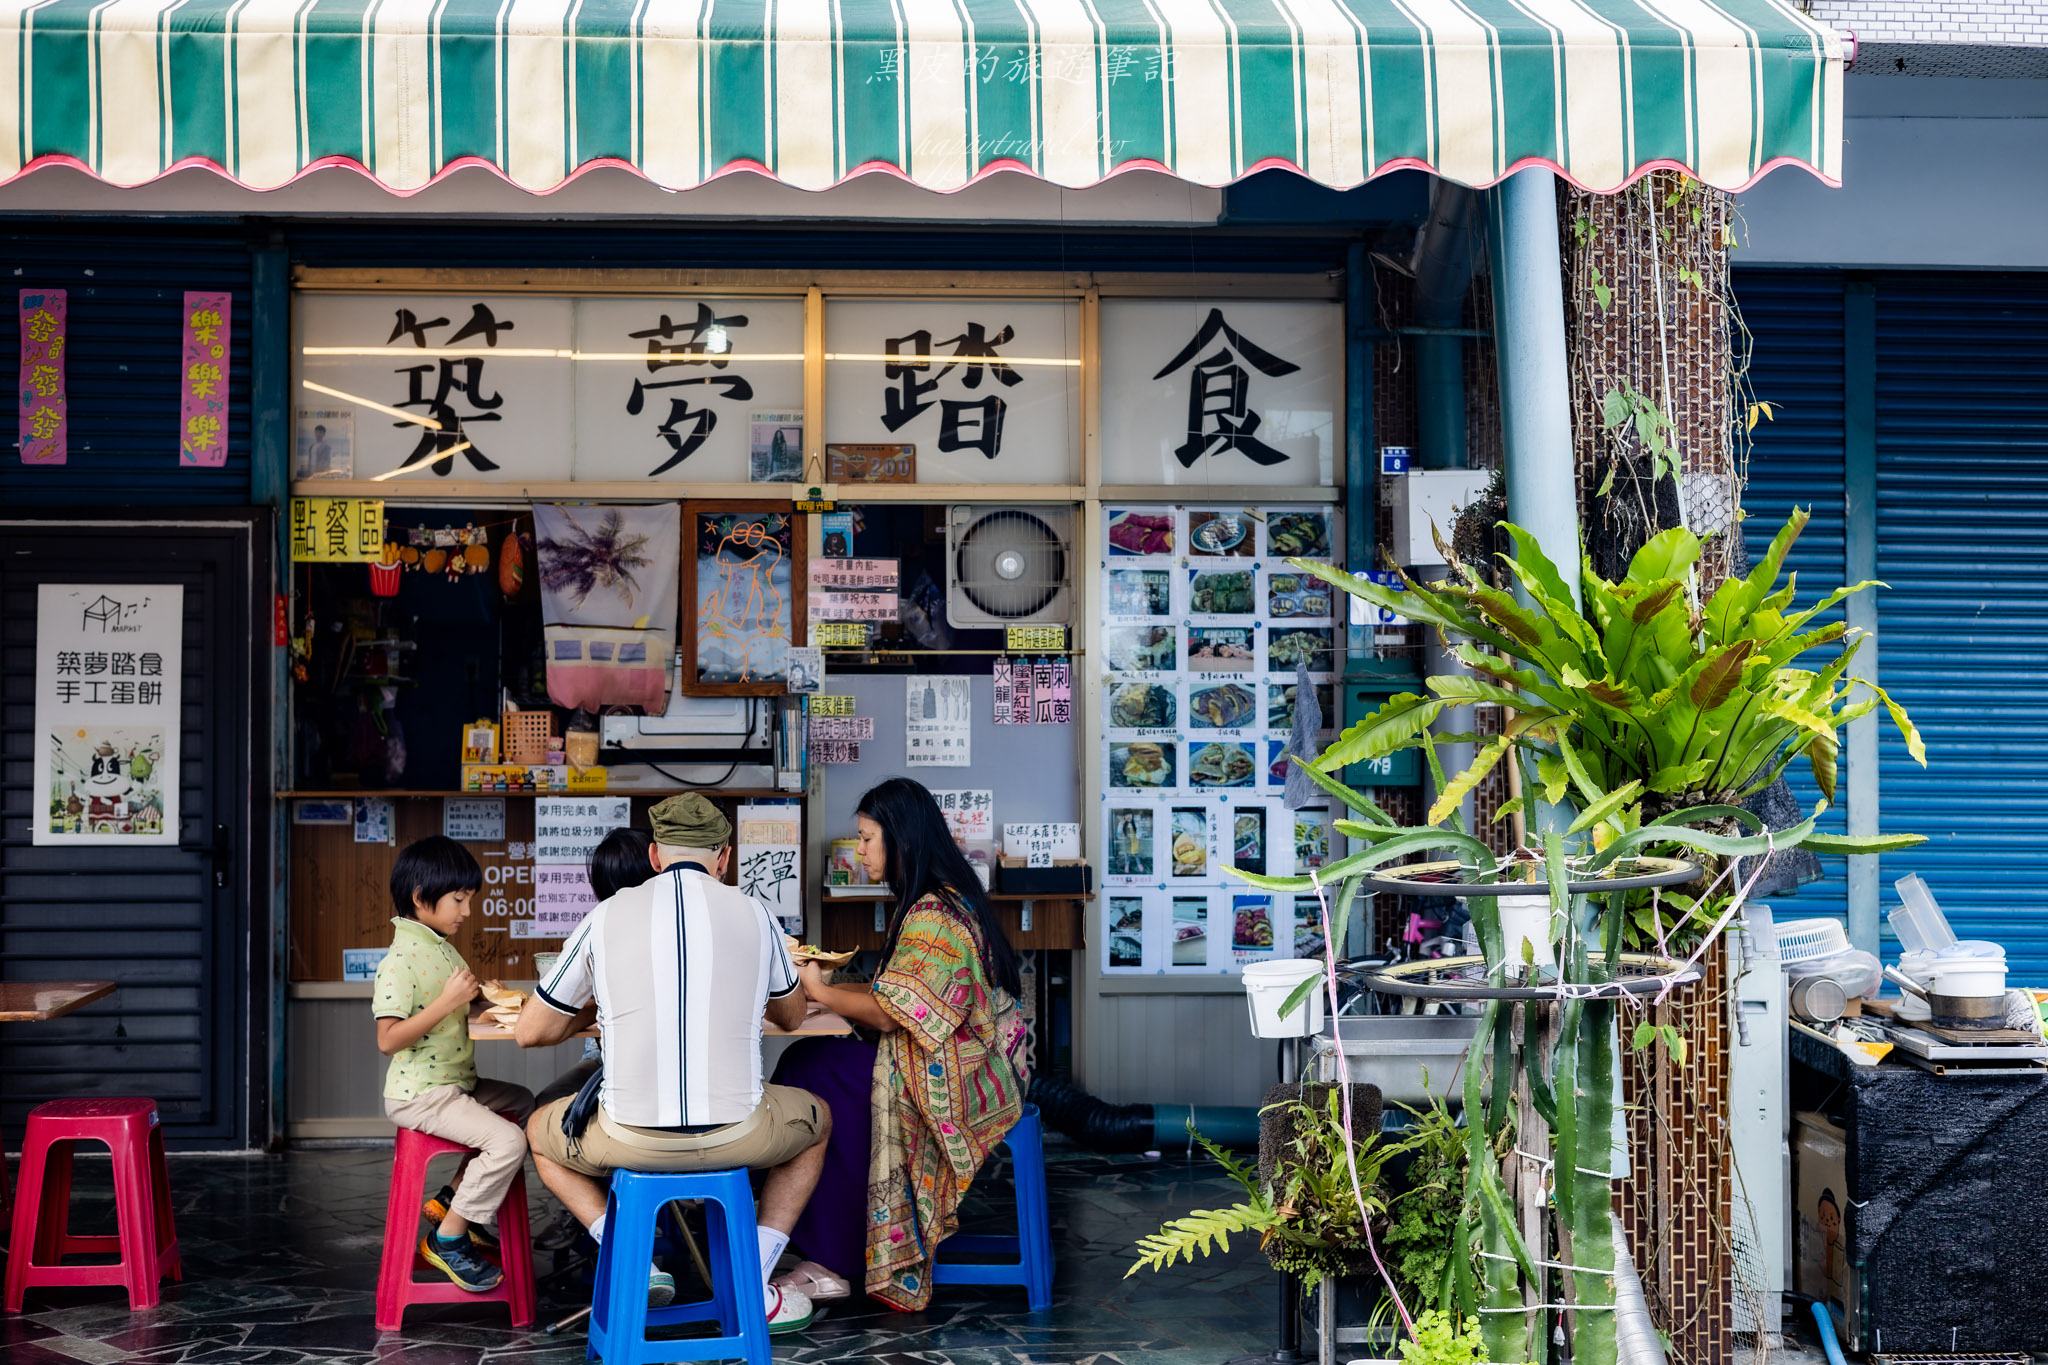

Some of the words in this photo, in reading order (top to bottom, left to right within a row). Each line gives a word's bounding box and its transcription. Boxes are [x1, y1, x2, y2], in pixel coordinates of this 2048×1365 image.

[26, 309, 63, 439] 發發發
[186, 309, 223, 451] 樂樂樂
[386, 302, 1301, 476] 築夢踏食
[1393, 458, 1402, 470] 8
[294, 500, 381, 556] 點餐區
[56, 651, 163, 677] 築夢踏食
[56, 681, 162, 705] 手工蛋餅
[810, 697, 855, 716] 店家推薦
[995, 664, 1011, 723] 火龍果
[1013, 665, 1031, 724] 蜜香紅茶
[1034, 664, 1053, 723] 南瓜
[1053, 664, 1071, 723] 刺蔥
[538, 804, 598, 817] 享用完美食
[489, 889, 505, 897] AM
[538, 893, 598, 903] 也別忘了收拾
[741, 850, 797, 904] 菜單
[538, 911, 589, 922] 感謝您的
